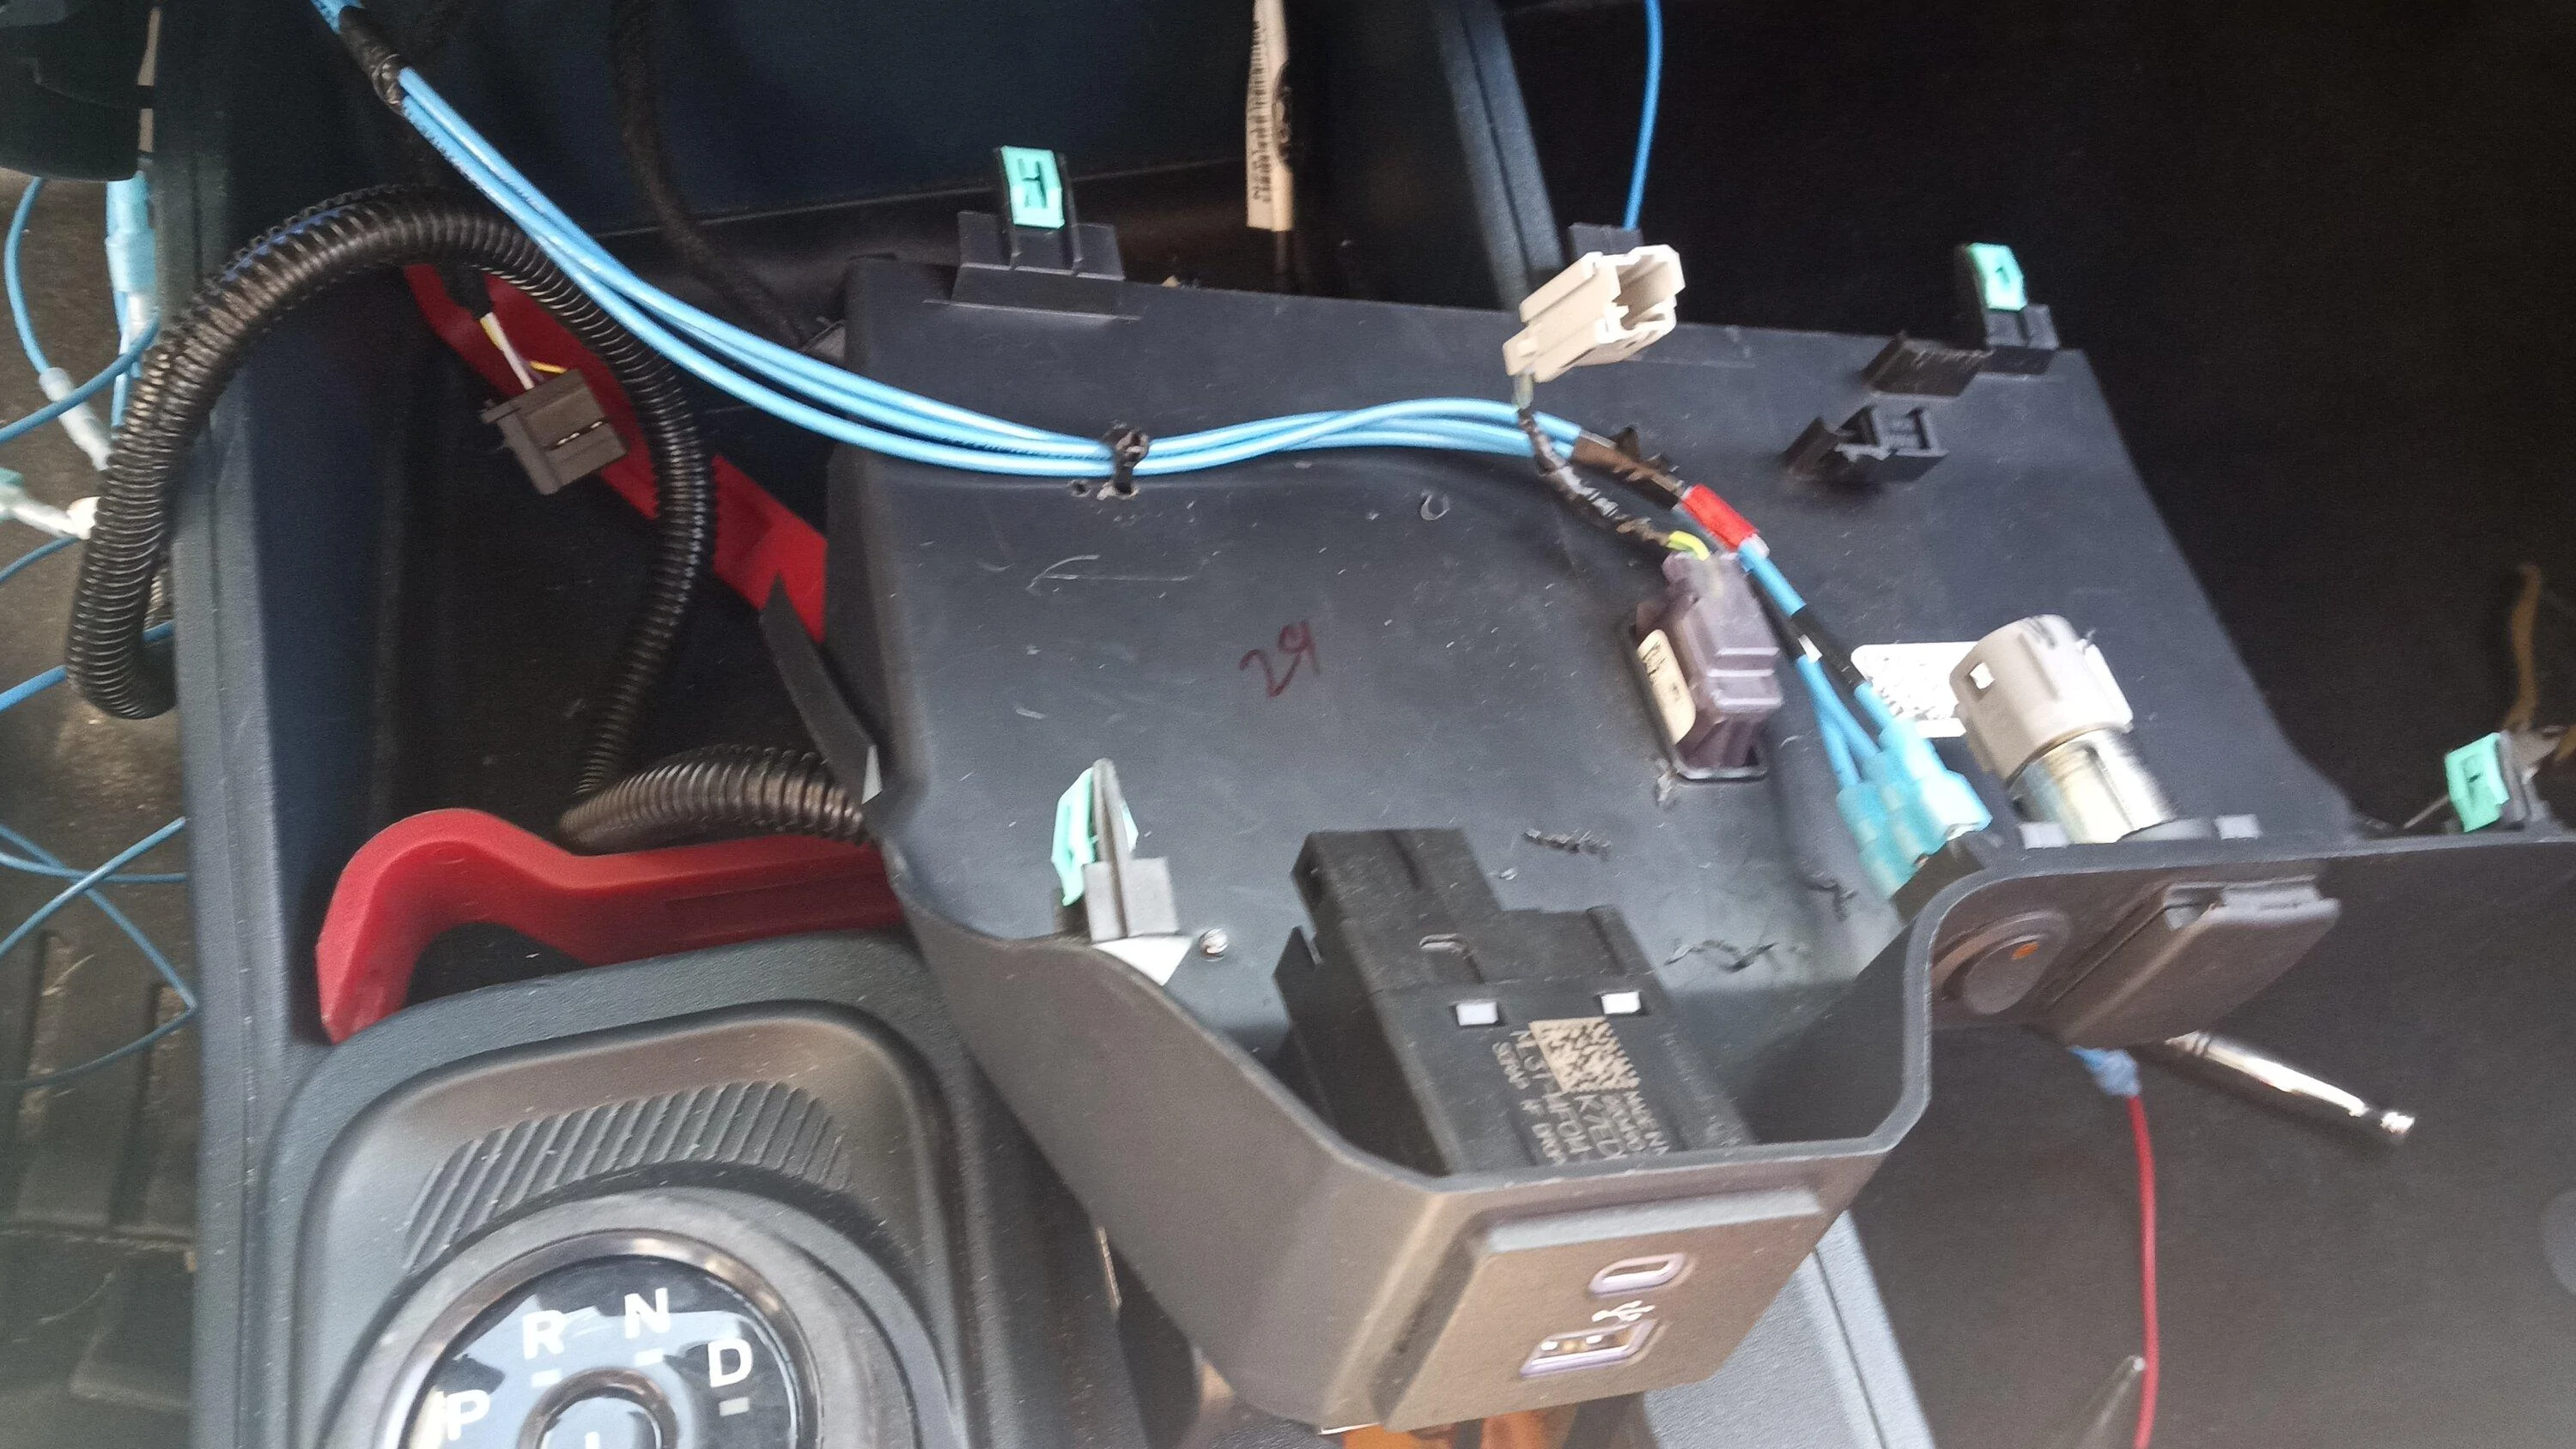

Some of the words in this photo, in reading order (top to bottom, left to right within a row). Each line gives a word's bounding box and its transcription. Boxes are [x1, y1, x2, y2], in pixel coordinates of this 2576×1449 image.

[446, 1389, 490, 1441] P
[522, 1309, 567, 1360] R
[623, 1287, 670, 1340] N
[707, 1337, 753, 1389] D
